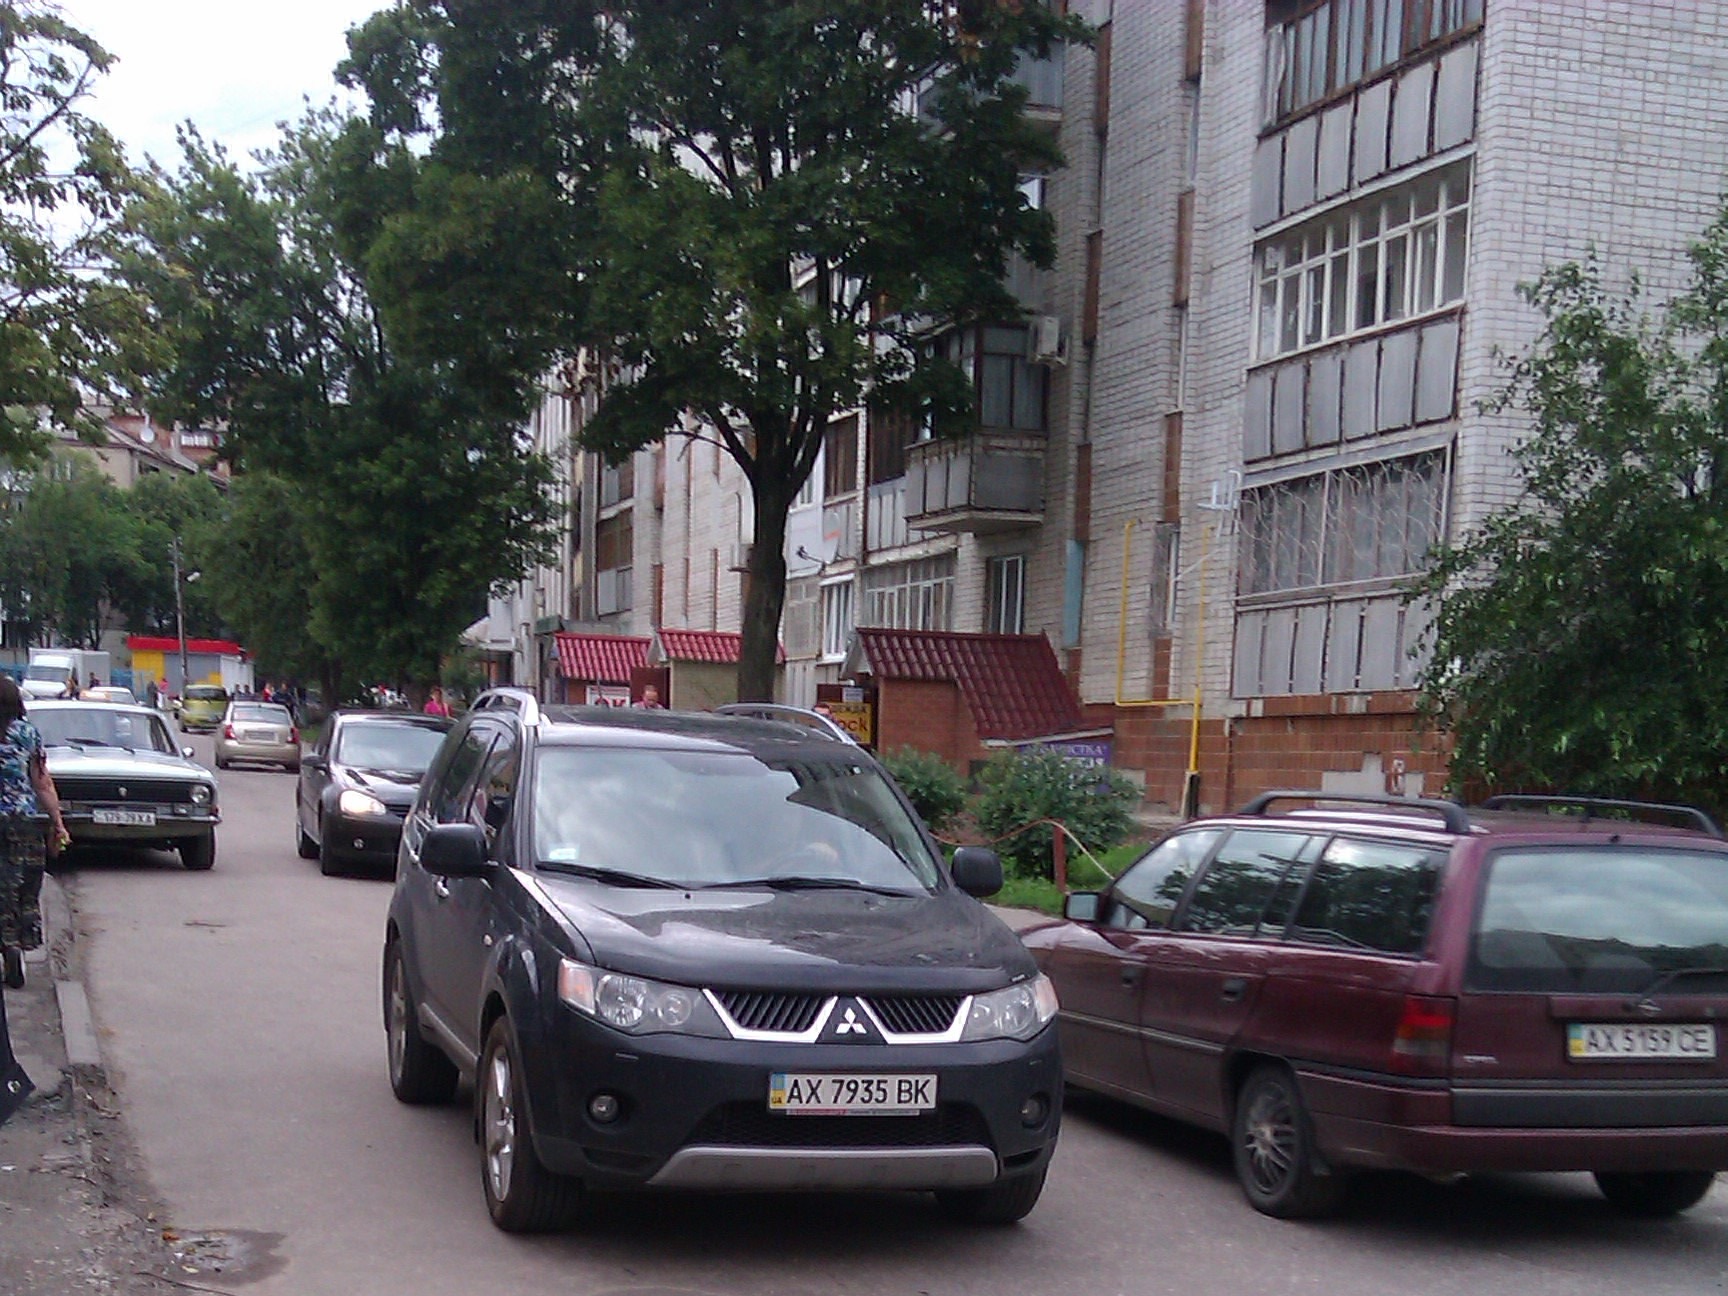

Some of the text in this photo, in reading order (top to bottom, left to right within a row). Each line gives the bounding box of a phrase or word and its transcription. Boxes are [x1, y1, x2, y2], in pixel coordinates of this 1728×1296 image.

[786, 1078, 931, 1105] AX 7935 BK
